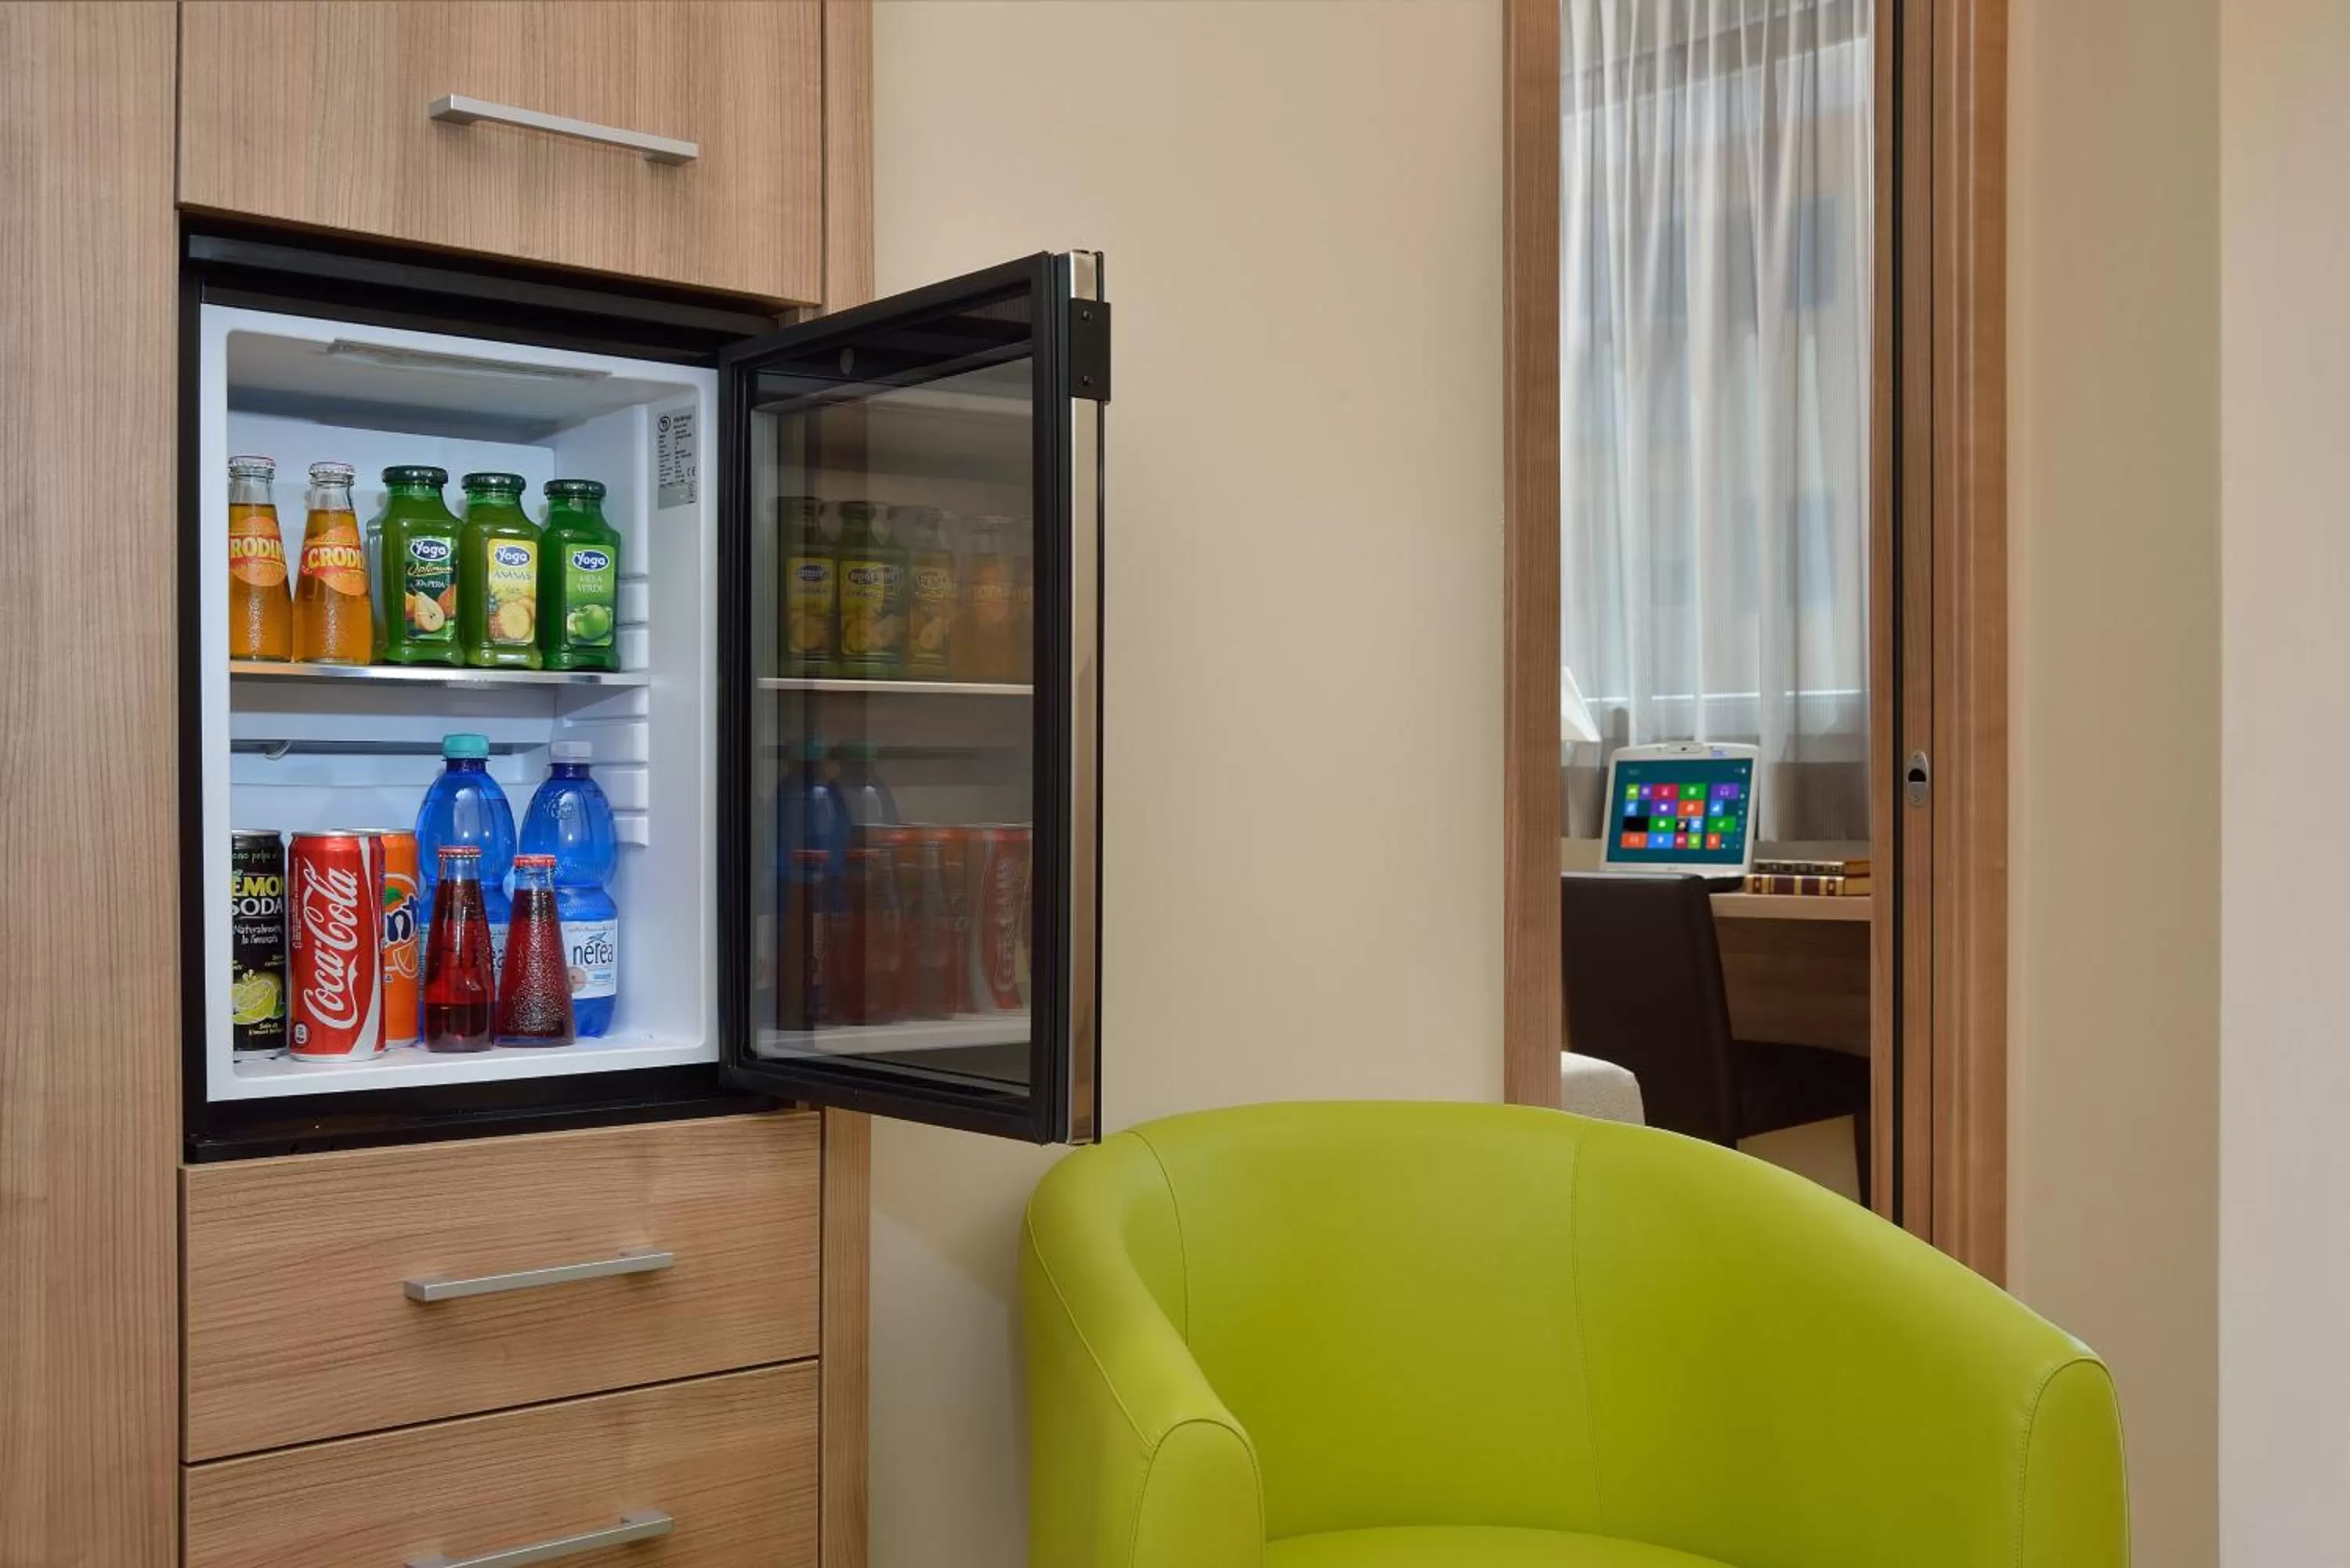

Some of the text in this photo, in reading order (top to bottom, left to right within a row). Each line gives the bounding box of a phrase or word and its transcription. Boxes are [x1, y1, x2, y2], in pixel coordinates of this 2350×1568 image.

[415, 541, 446, 558] Yoga
[499, 547, 528, 565] Yoga
[577, 551, 606, 569] Yoga
[303, 856, 358, 1030] Coca-Cola
